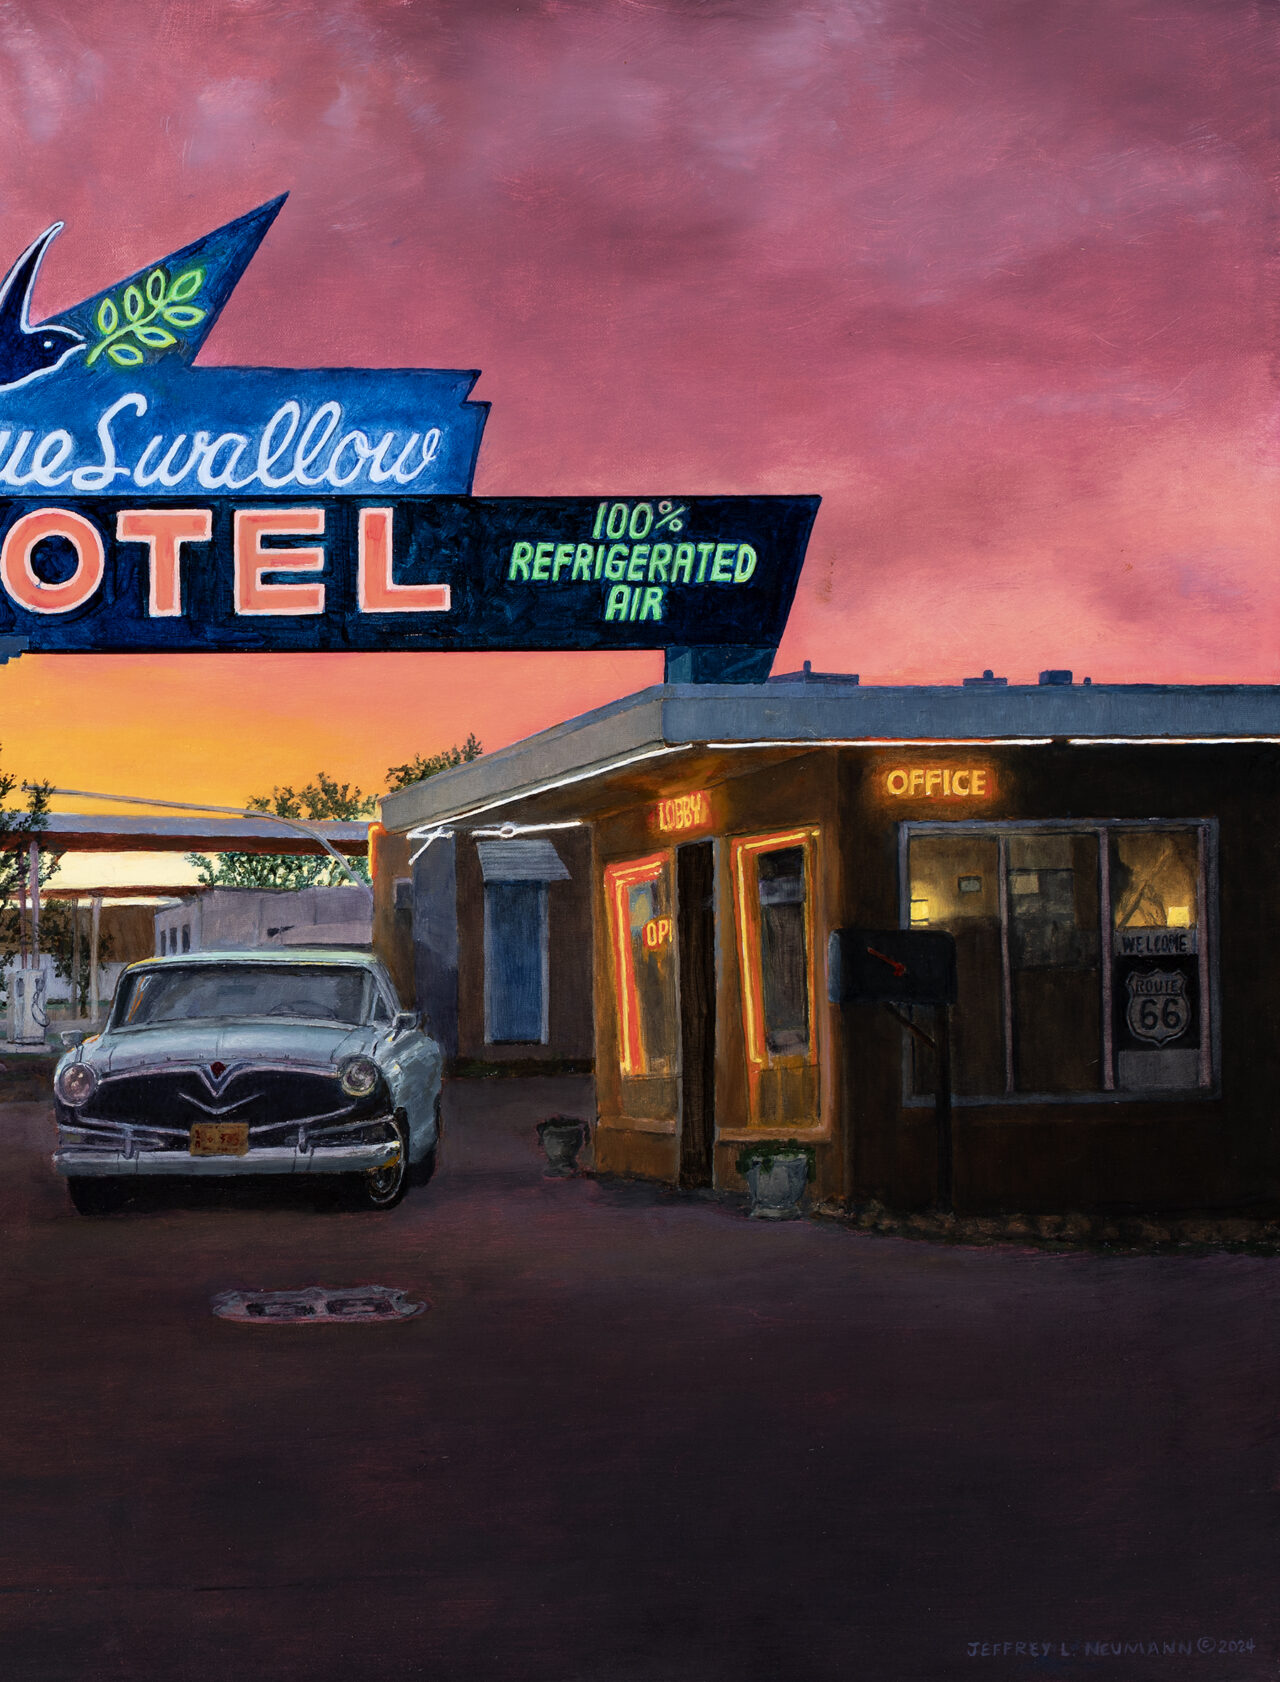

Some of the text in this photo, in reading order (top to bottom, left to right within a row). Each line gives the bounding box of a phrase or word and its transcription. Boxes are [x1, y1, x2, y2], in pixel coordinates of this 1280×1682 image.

[71, 392, 441, 491] Swallow
[591, 500, 687, 539] 100%
[507, 541, 757, 583] REFRIGERATED
[604, 585, 664, 622] AIR
[886, 769, 987, 796] OFFICE
[658, 792, 702, 832] LOBBY
[646, 919, 673, 947] OP
[1121, 933, 1188, 954] WELCOME
[1135, 979, 1178, 994] ROUTE
[1141, 998, 1181, 1031] 66
[967, 1641, 1052, 1657] JEFFREY
[1084, 1641, 1193, 1657] NEUMANN
